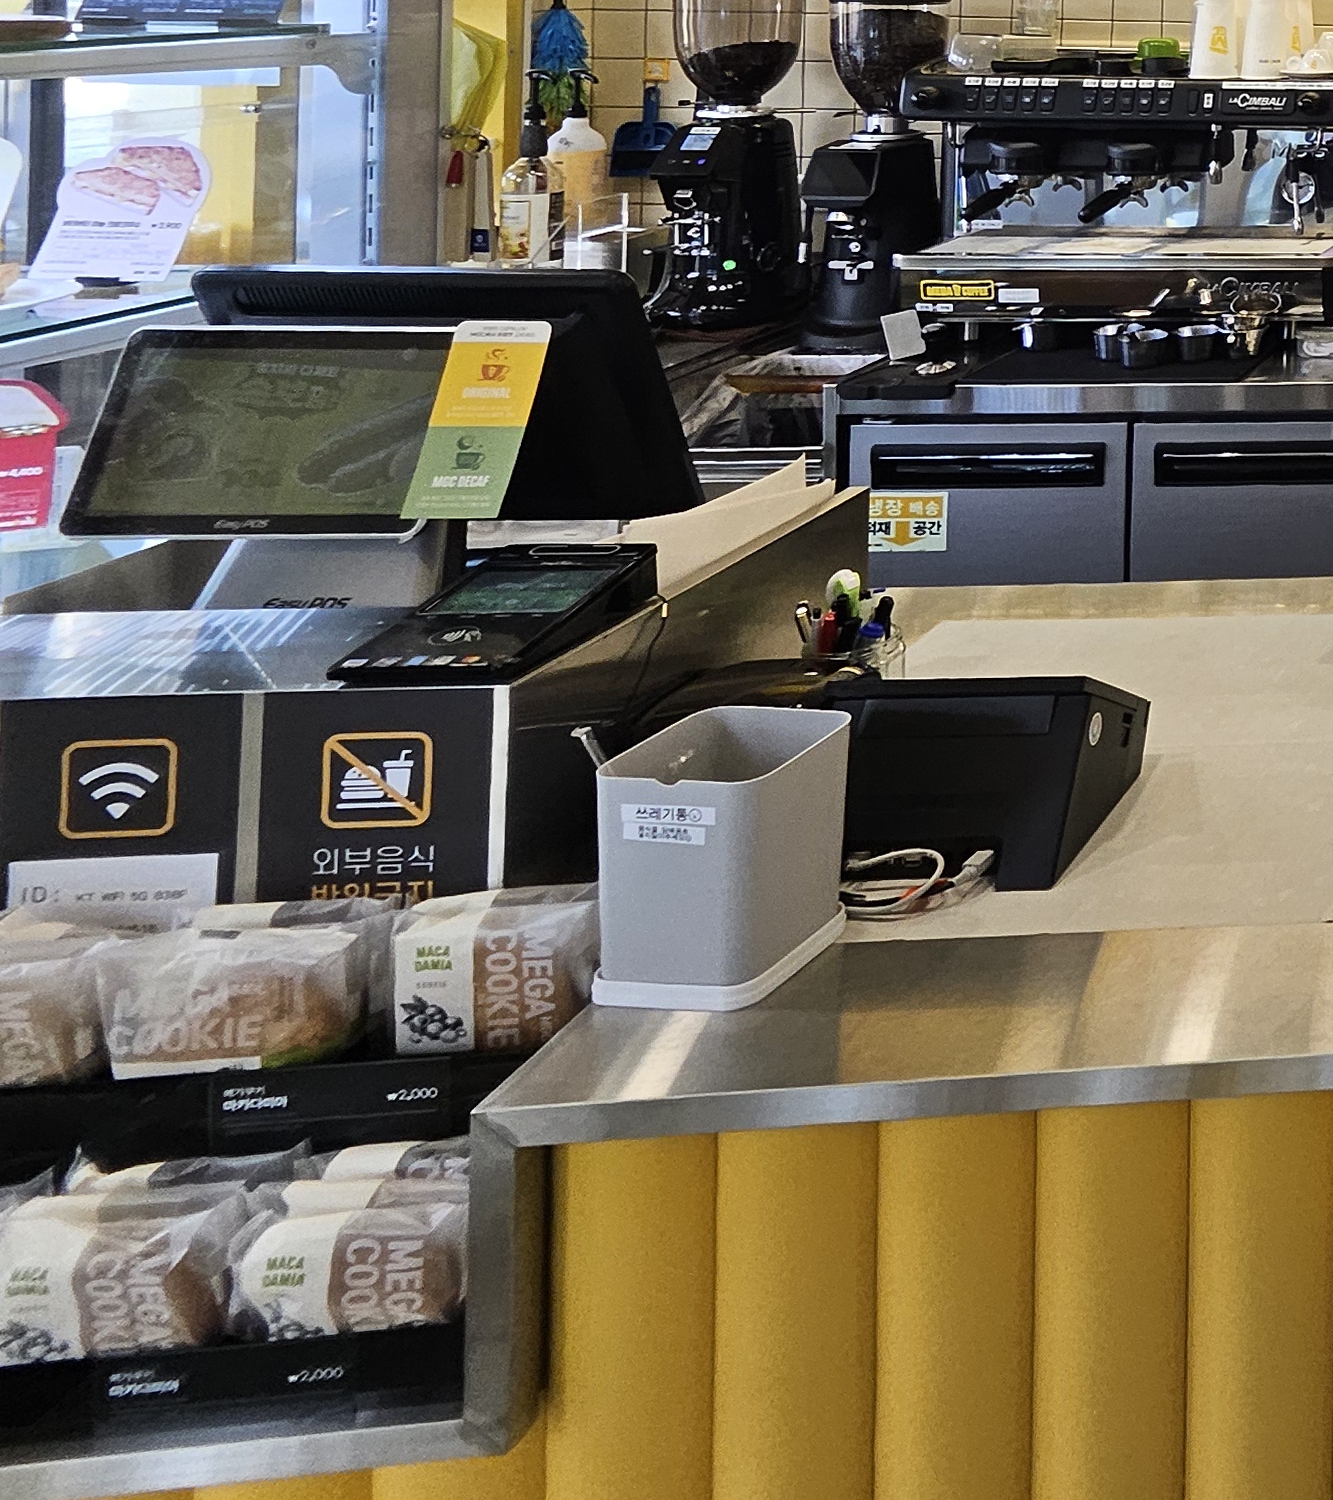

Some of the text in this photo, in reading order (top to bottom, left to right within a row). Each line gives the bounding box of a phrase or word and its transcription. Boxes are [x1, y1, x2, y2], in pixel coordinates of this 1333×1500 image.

[1238, 92, 1287, 108] CIMBALI
[462, 387, 511, 399] ORIGINAL
[909, 501, 940, 516] 배송
[913, 521, 942, 535] 공간
[263, 596, 352, 610] EasyPOS
[636, 807, 687, 821] 쓰레기통
[312, 846, 436, 875] 외부음식
[415, 946, 450, 957] MACA
[414, 958, 452, 972] DAMIA
[521, 926, 554, 1020] MEGA
[484, 931, 521, 1047] COOKIE
[265, 1256, 304, 1270] MACA
